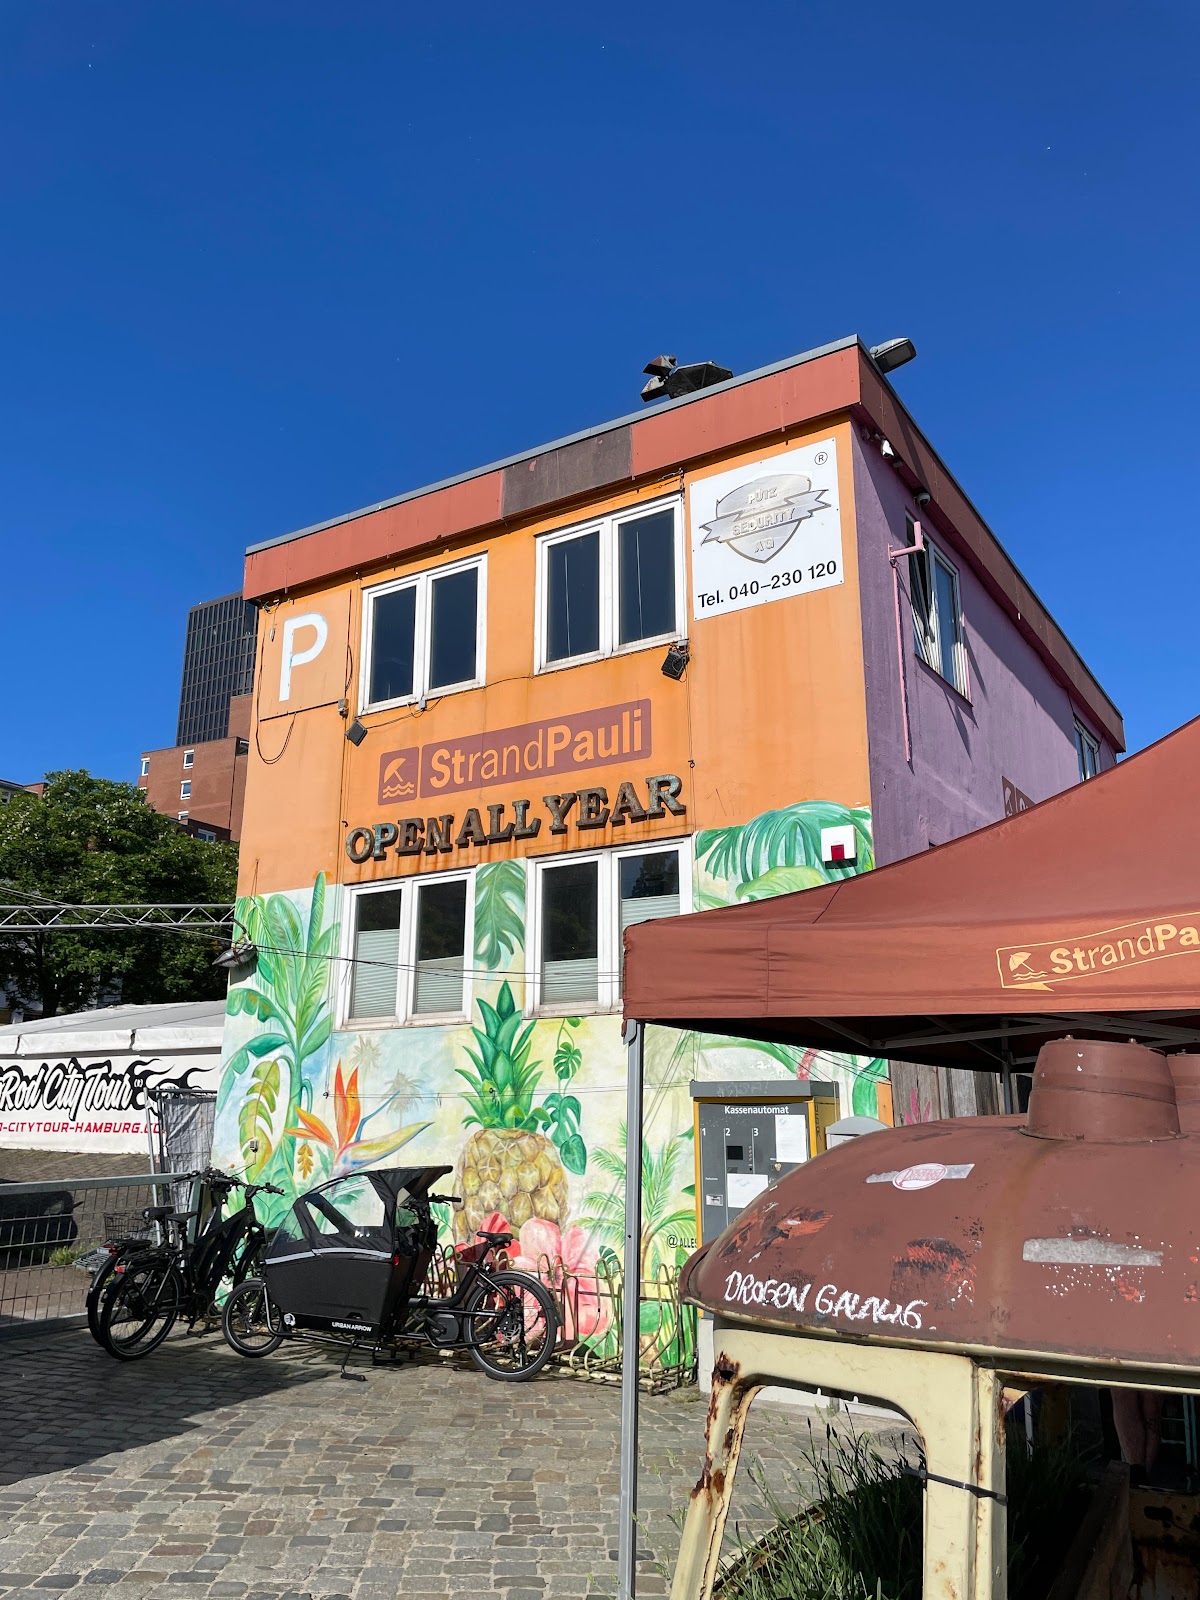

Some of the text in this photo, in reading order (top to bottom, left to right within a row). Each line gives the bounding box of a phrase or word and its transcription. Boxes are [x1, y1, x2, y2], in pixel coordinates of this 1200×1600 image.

[754, 538, 775, 553] AG
[697, 590, 725, 608] Tel.
[808, 560, 837, 580] 120
[279, 612, 328, 702] P
[429, 708, 643, 789] StrandPauli
[345, 774, 687, 864] OPEN ALL YEAR
[724, 1105, 790, 1115] Kassenautomat
[725, 1128, 731, 1136] 2
[753, 1128, 759, 1136] 3
[332, 1321, 373, 1332] URBAN ARROW
